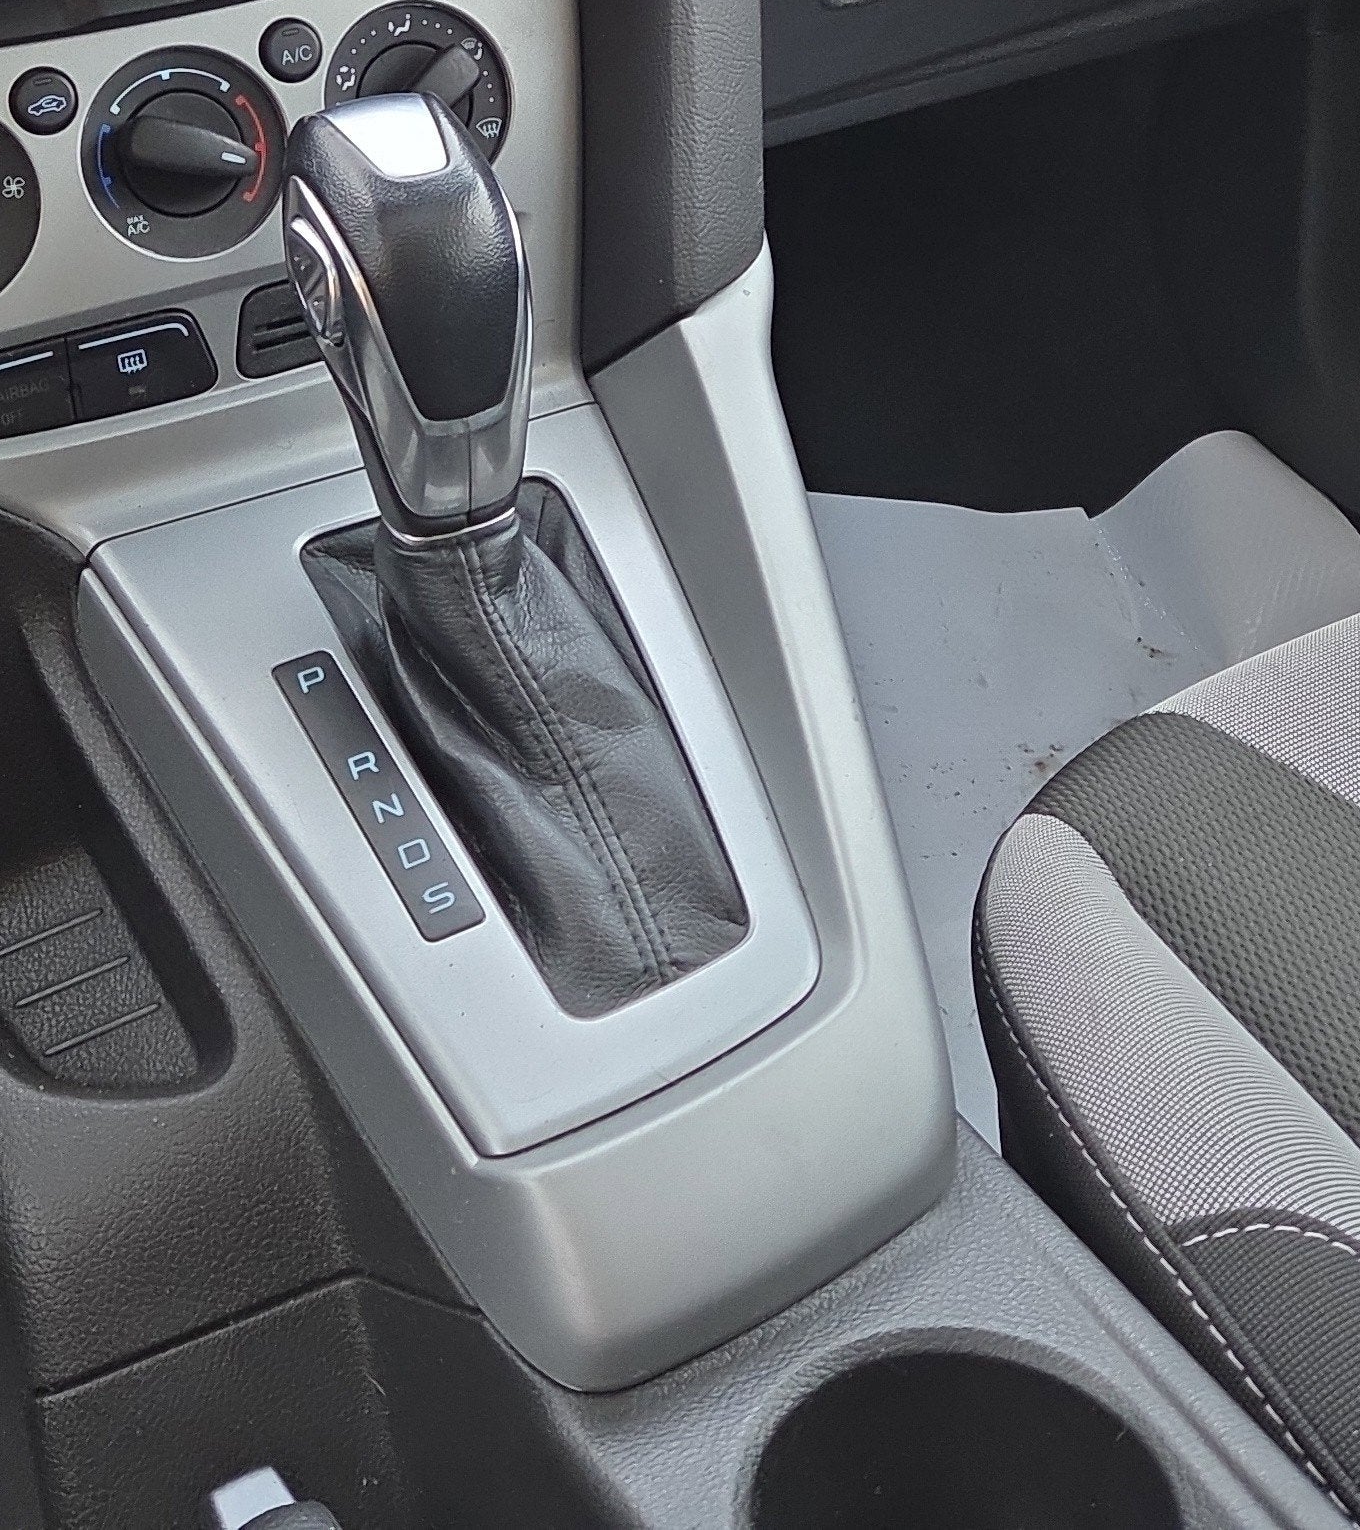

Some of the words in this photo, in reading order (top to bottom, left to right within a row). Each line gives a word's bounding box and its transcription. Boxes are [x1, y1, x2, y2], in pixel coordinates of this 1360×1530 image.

[281, 44, 313, 66] A/C
[296, 666, 326, 694] P
[347, 750, 380, 781] R
[371, 793, 406, 824] N
[397, 837, 431, 870] D
[421, 881, 457, 915] S
